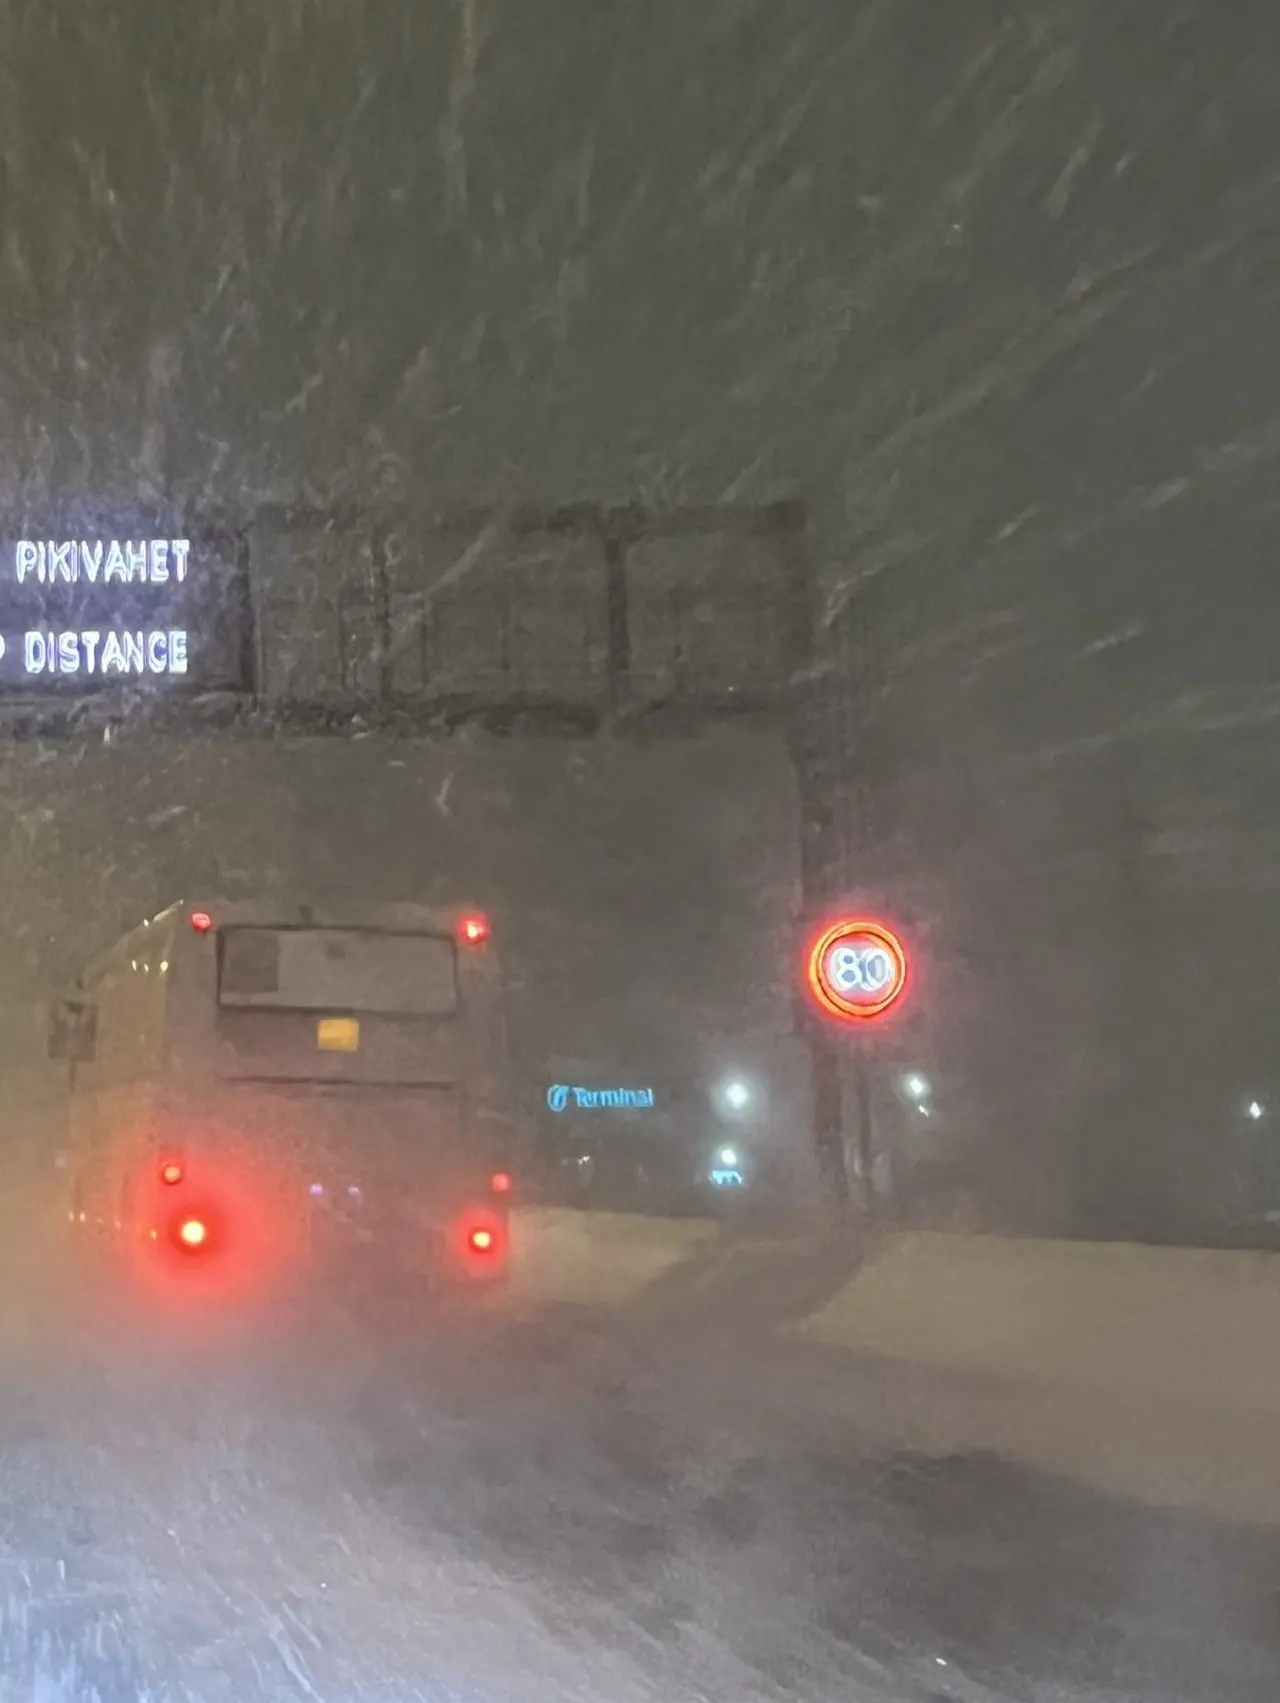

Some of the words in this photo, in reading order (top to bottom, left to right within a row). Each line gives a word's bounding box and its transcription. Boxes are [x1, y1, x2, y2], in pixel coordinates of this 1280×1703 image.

[16, 539, 190, 583] PIKIVAHET
[25, 631, 188, 674] DISTANCE
[829, 947, 891, 991] 80
[572, 1087, 654, 1107] Terminal
